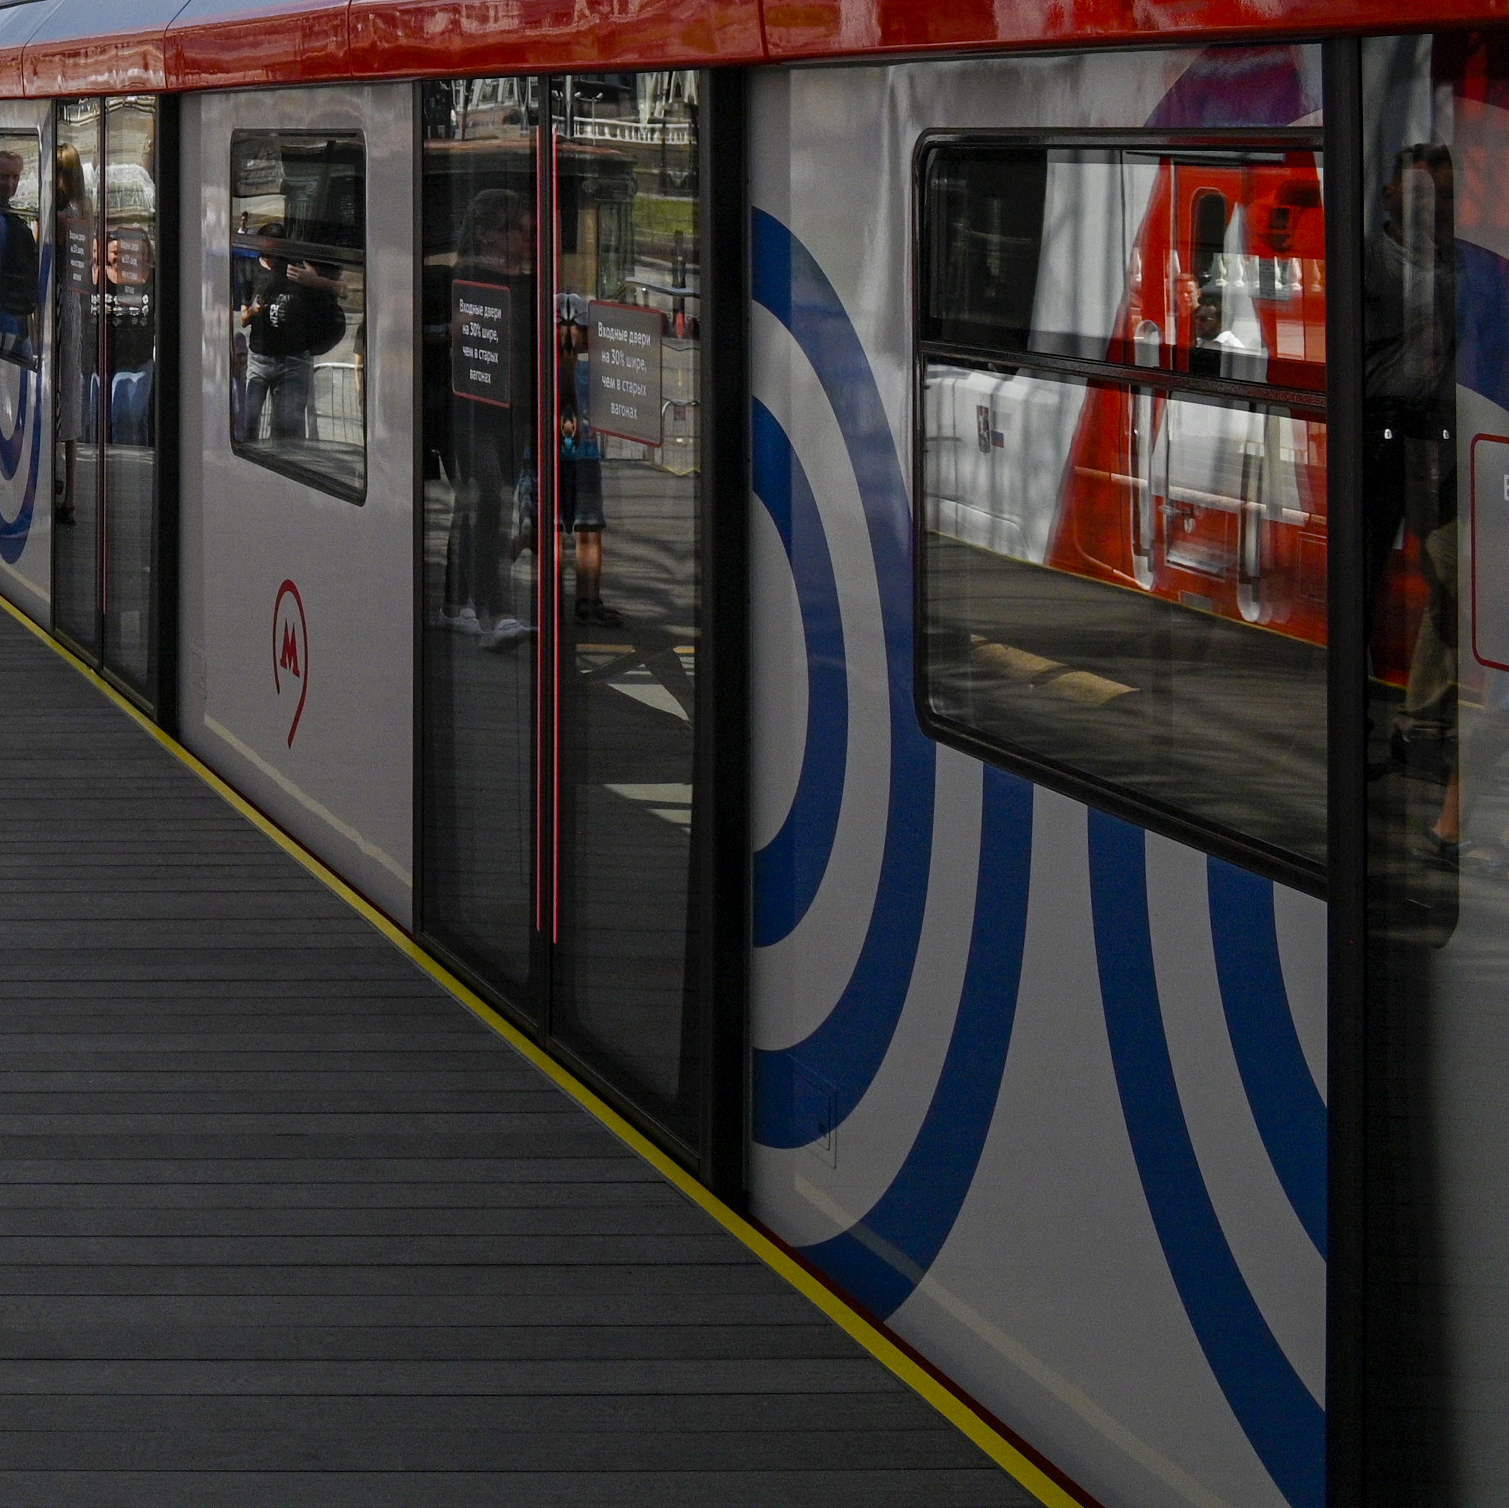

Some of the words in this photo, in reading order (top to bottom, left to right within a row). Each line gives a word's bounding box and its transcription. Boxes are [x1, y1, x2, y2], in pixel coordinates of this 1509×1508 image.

[597, 321, 628, 342] Входные
[628, 331, 651, 348] двери
[601, 351, 610, 364] на
[610, 348, 625, 367] 30%
[625, 357, 647, 373] шире,
[601, 375, 615, 390] чем
[616, 378, 621, 390] в
[622, 379, 647, 397] старых
[610, 402, 638, 420] вагонах
